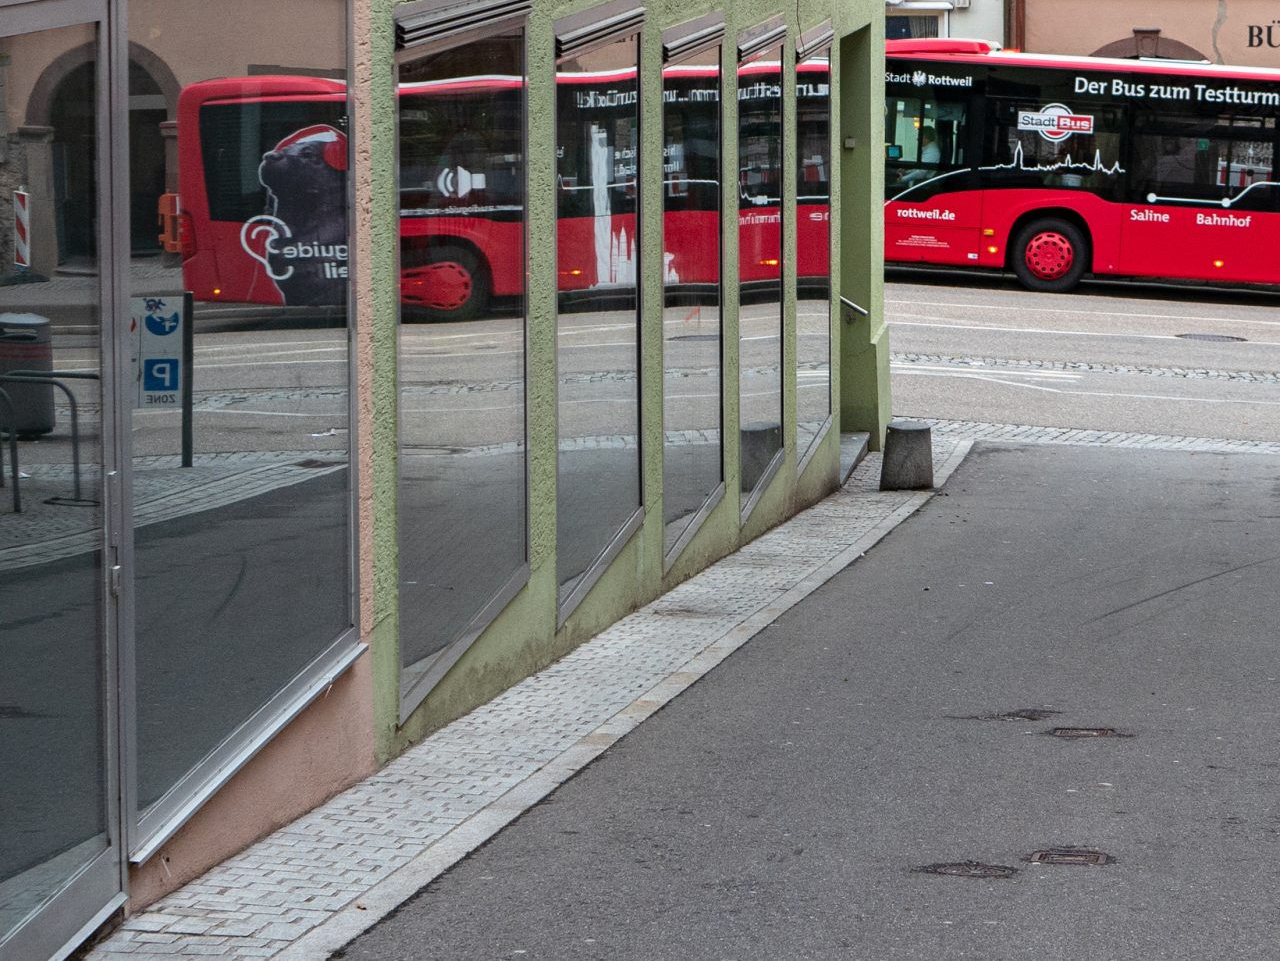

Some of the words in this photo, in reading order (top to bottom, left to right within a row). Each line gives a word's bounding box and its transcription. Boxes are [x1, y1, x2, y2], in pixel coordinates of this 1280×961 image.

[884, 72, 911, 84] Stadt
[927, 74, 973, 87] Rottweil
[1074, 76, 1107, 94] Der
[1112, 82, 1145, 97] Bus
[1149, 87, 1191, 100] zum
[897, 208, 956, 221] rottweil.de
[1130, 209, 1170, 223] Saline
[1196, 213, 1252, 228] Bahnhof
